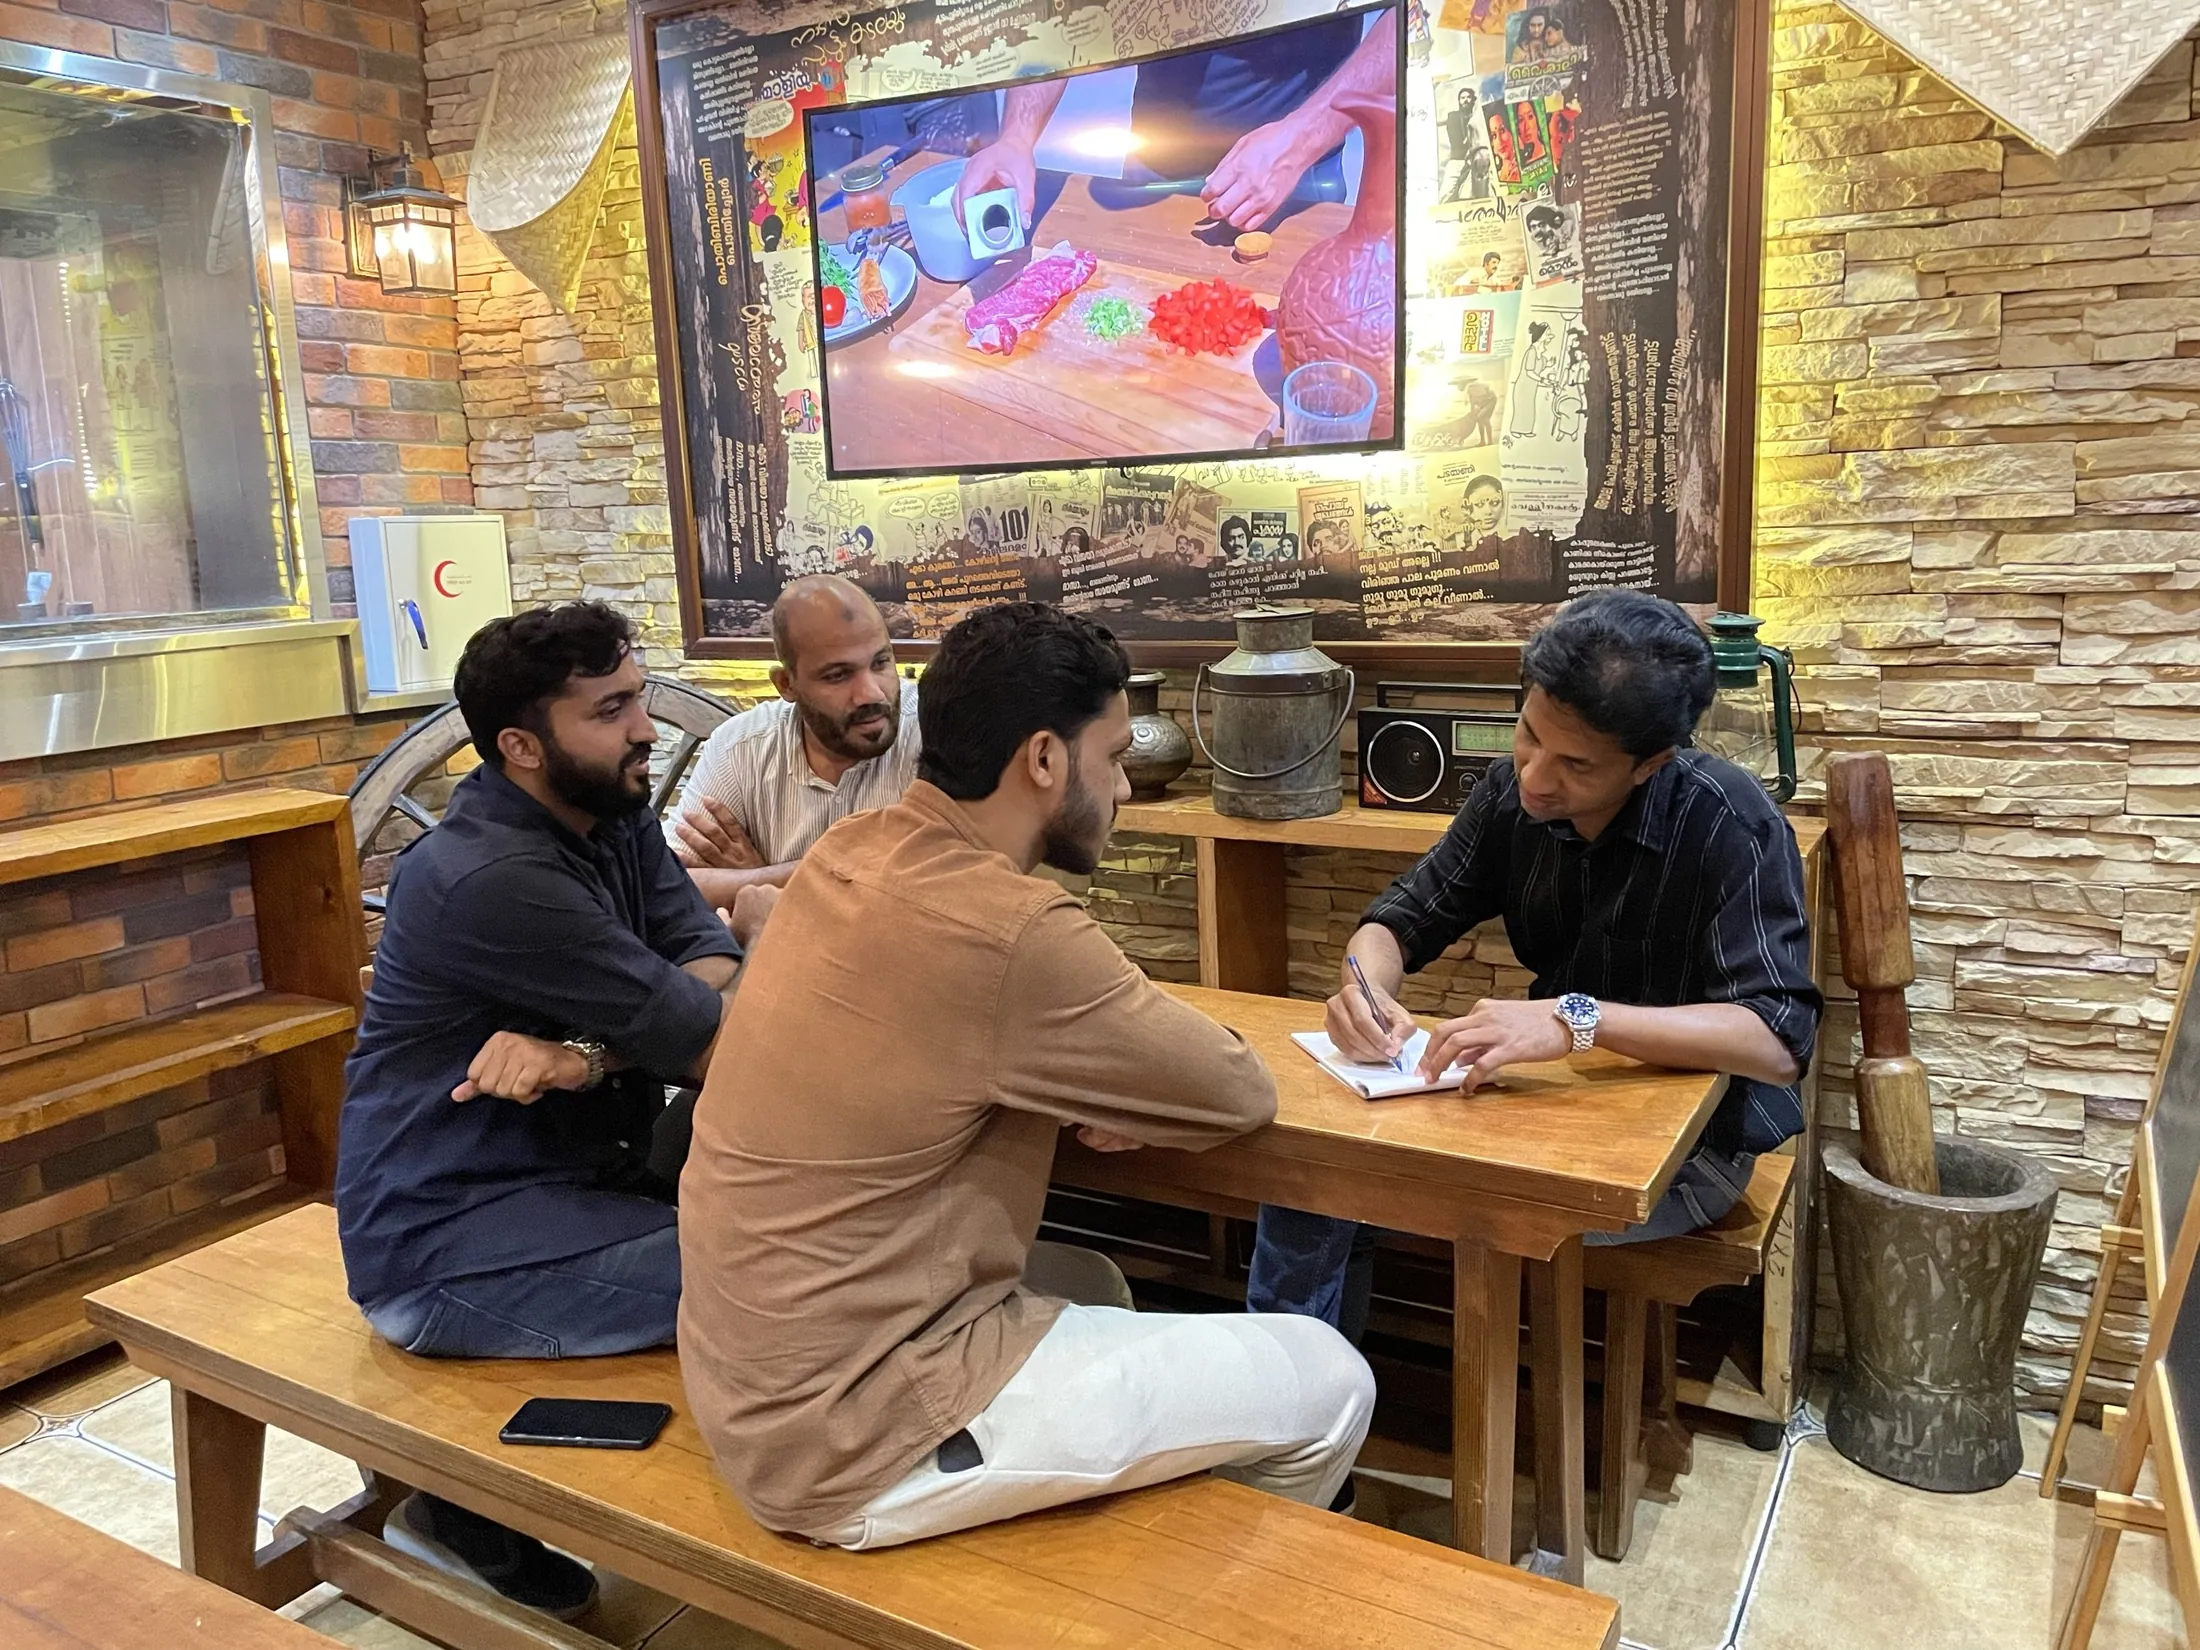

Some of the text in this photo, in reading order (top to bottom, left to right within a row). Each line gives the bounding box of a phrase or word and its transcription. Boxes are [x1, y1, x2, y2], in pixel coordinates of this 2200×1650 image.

[850, 9, 907, 44] കടലയും
[699, 158, 728, 286] പൊതിബിരിയാണി
[718, 178, 735, 266] പൊതിച്ചോർ
[718, 342, 748, 391] നാടൻ
[1665, 386, 1679, 402] വാ
[1000, 506, 1029, 544] 101
[1359, 563, 1377, 576] നല്ല
[1402, 572, 1422, 584] പാല
[1463, 559, 1500, 574] വന്നാൽ
